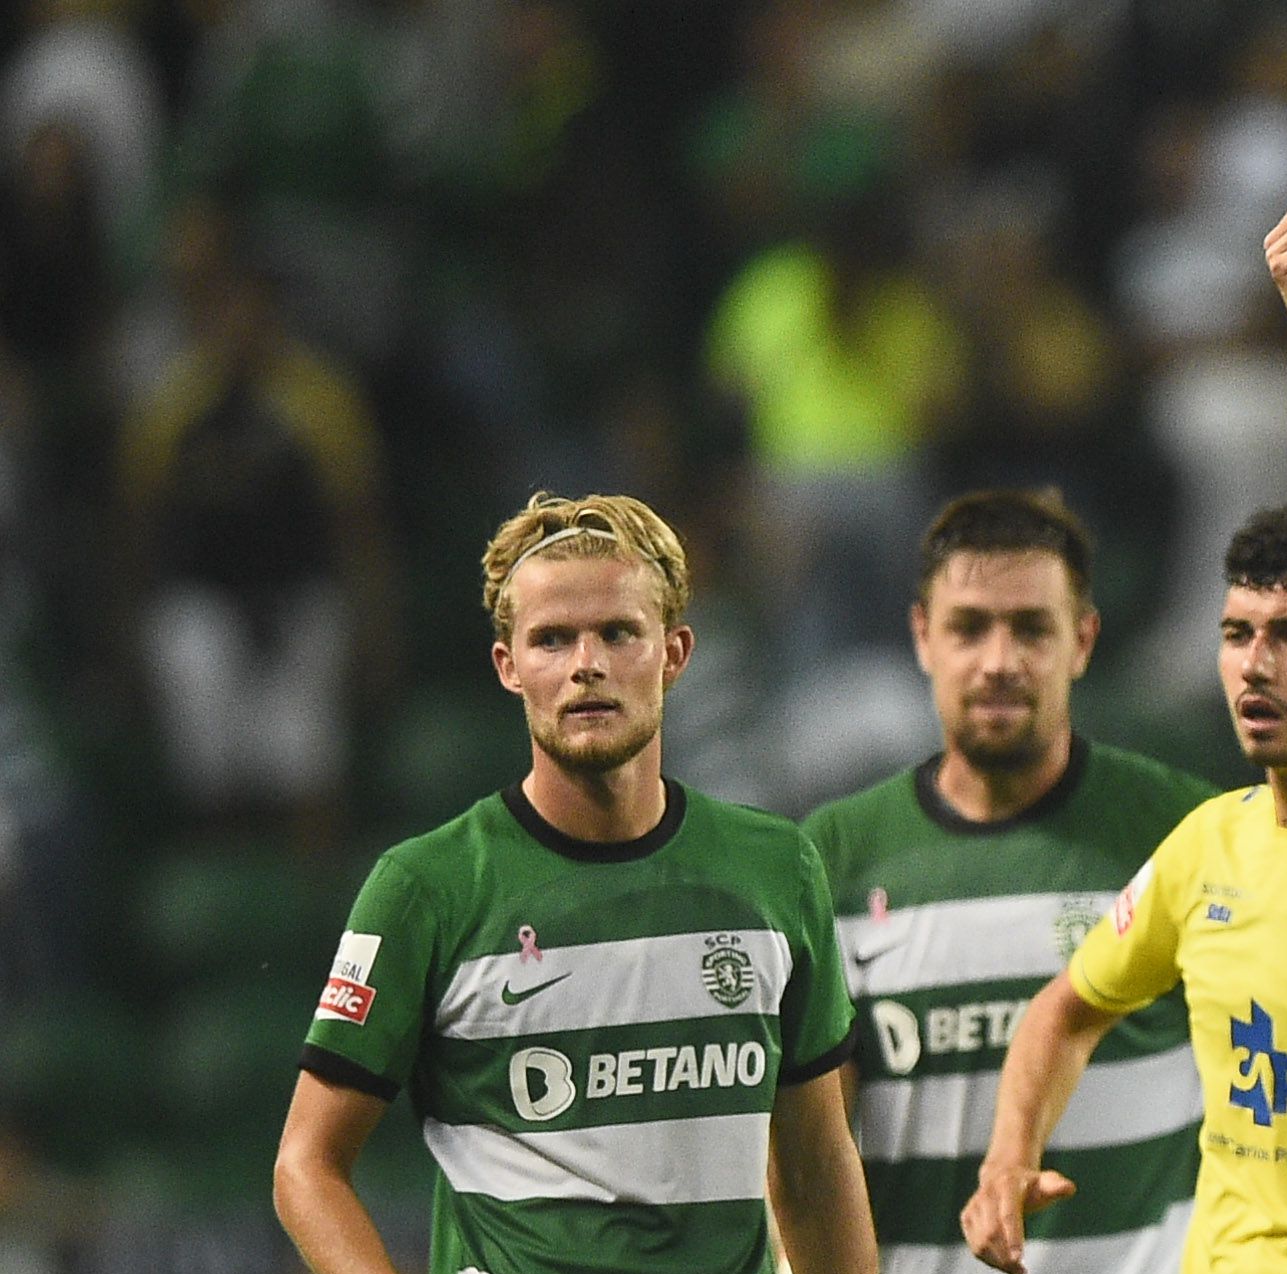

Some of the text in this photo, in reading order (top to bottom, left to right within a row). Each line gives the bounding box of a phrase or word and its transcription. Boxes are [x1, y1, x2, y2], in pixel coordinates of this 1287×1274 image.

[704, 933, 742, 949] SCP
[321, 982, 364, 1014] clic
[586, 1041, 767, 1100] BETANO
